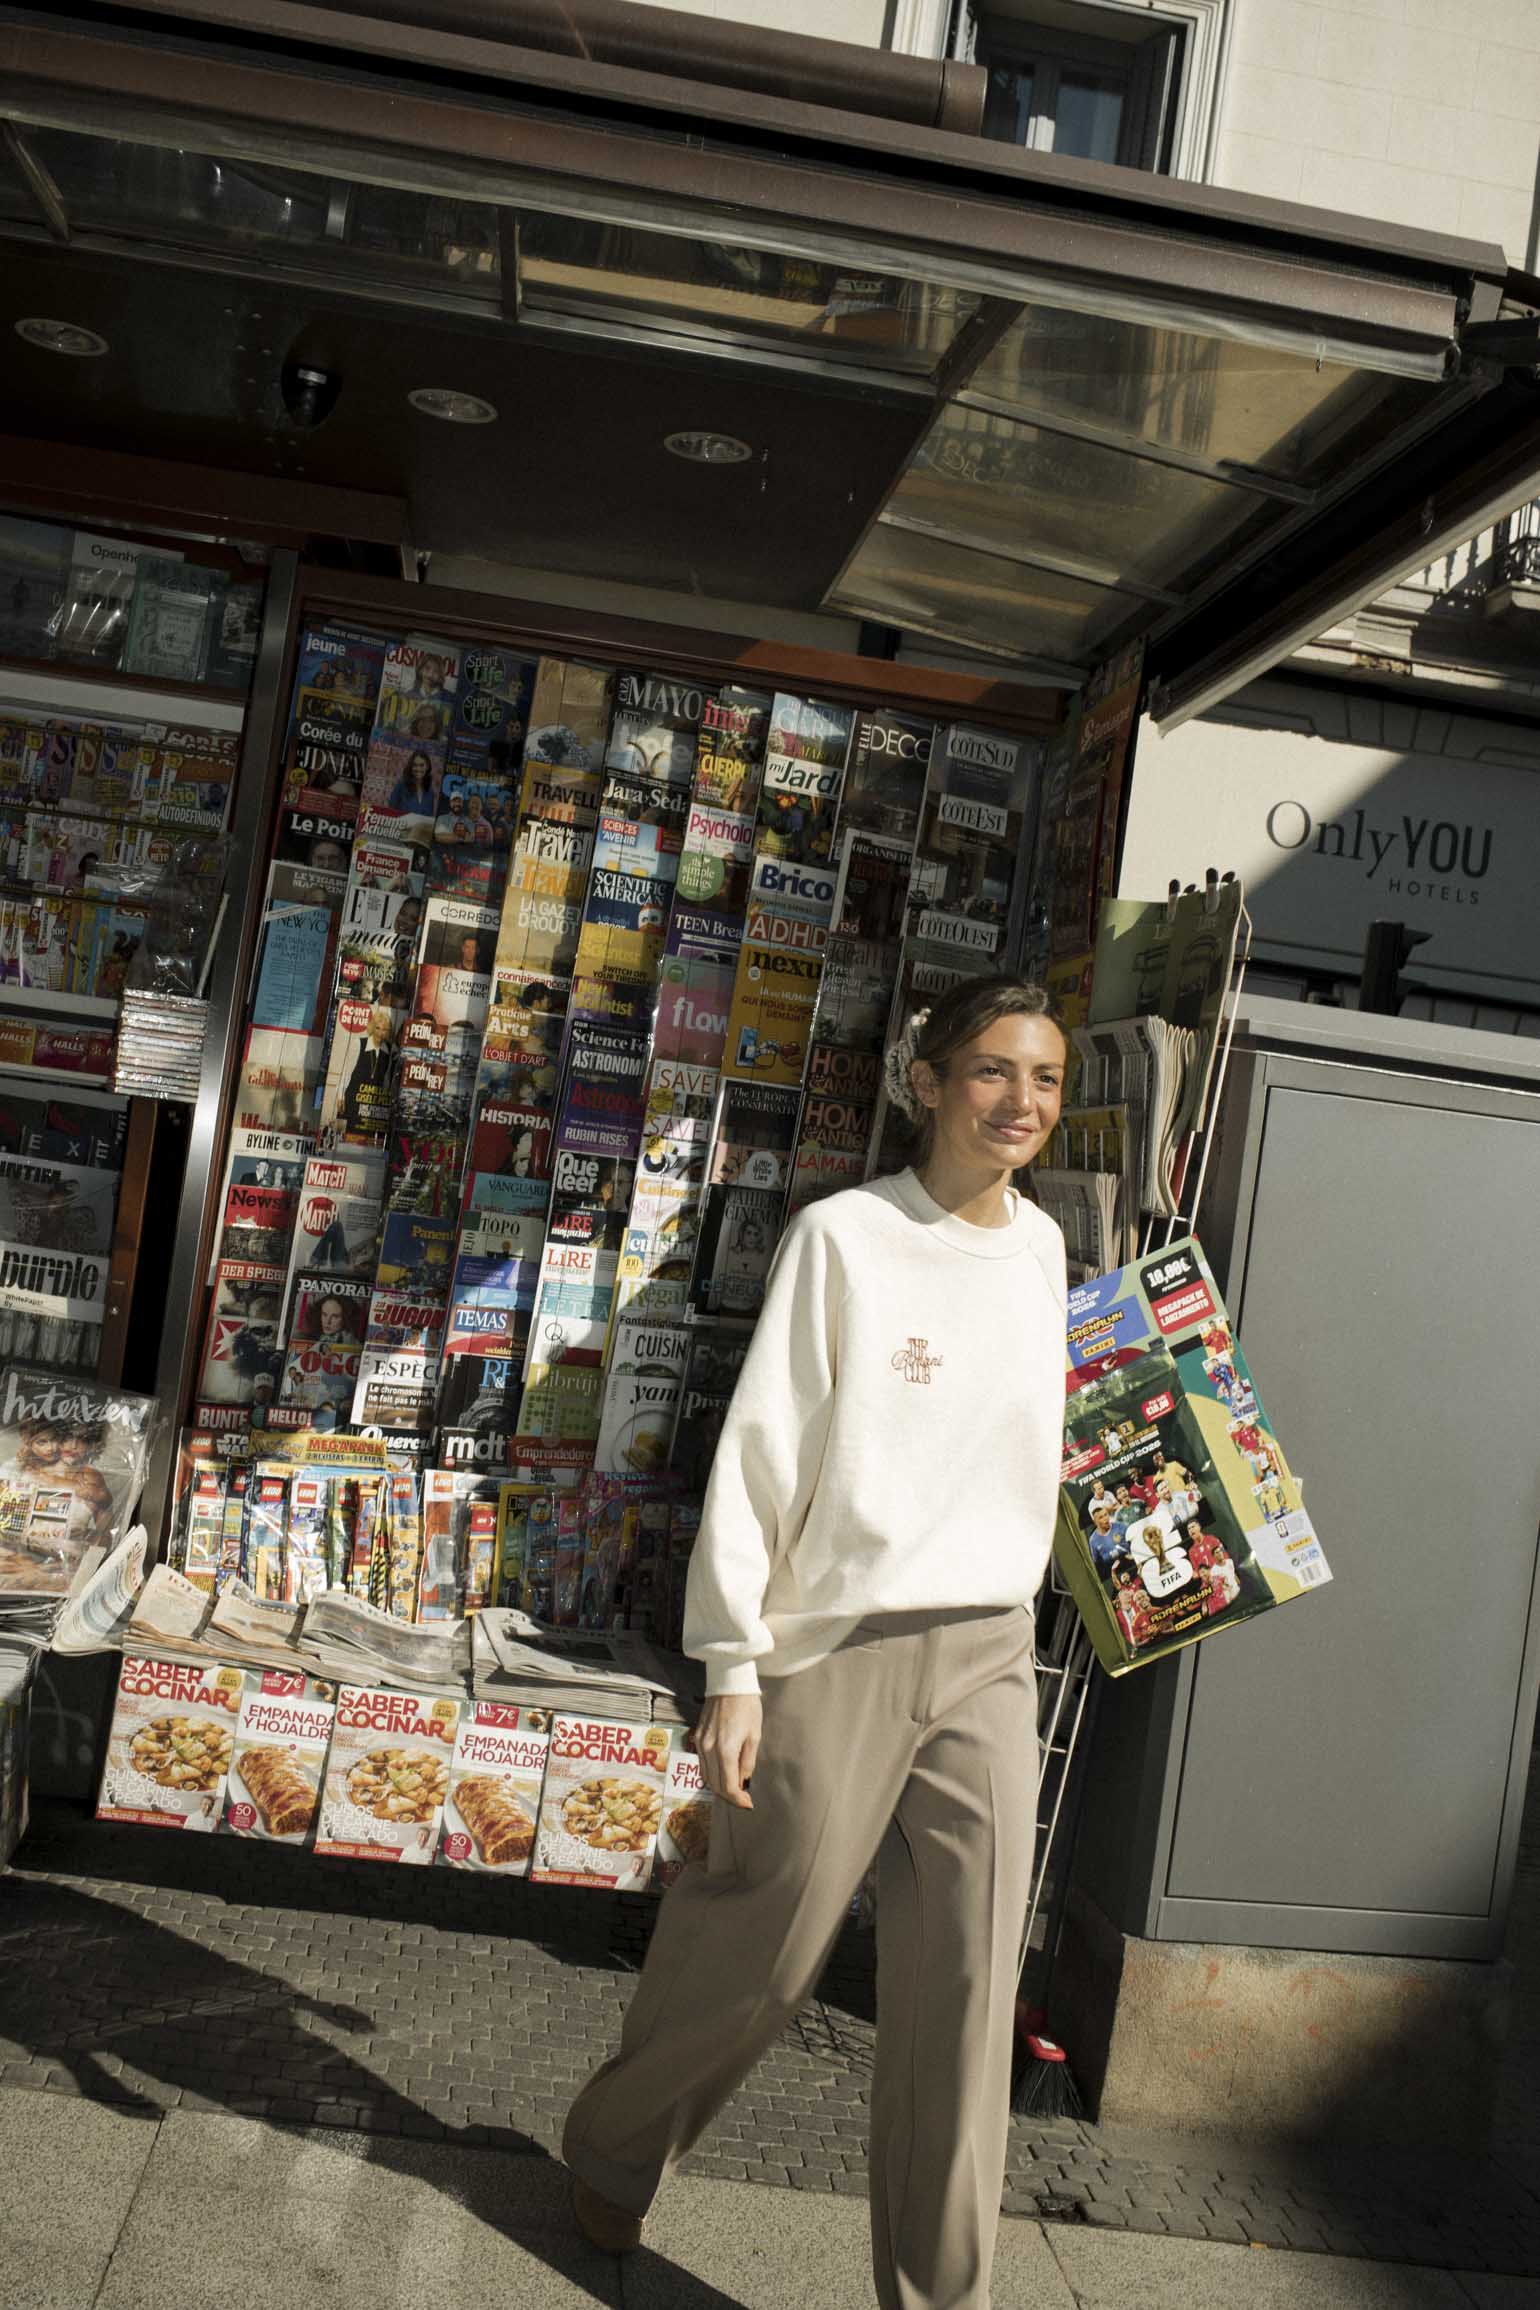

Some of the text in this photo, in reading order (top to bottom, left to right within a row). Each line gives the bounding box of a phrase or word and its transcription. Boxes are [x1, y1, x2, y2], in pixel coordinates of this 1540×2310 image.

[306, 633, 346, 657] jeune
[473, 667, 504, 686] Life
[470, 707, 501, 728] Life
[300, 721, 363, 748] Corée du
[603, 778, 643, 801] Jara
[291, 813, 313, 832] Le
[1266, 800, 1493, 878] Only YOU
[366, 853, 400, 867] France
[682, 865, 715, 879] simple
[595, 870, 669, 895] SCIENTIFIC
[682, 874, 712, 890] things
[760, 864, 833, 901] Brico
[1389, 878, 1480, 904] HOTELS
[520, 897, 538, 914] LA
[518, 912, 578, 936] DROUOT
[675, 914, 710, 934] TEEN
[342, 1006, 370, 1017] POINT
[342, 1015, 353, 1023] DE
[489, 1018, 529, 1037] Arts
[53, 1039, 85, 1051] HALLS
[572, 1028, 629, 1048] Science
[520, 1054, 547, 1067] D'ART
[733, 1087, 748, 1097] The
[479, 1108, 551, 1130] HISTORIA
[247, 1133, 281, 1150] BYLINE
[565, 1127, 629, 1146] RUBIN RISES
[559, 1152, 600, 1177] Que
[308, 1165, 346, 1187] MATCH
[302, 1203, 338, 1230] MATCH
[221, 1263, 245, 1278] DER
[455, 1310, 507, 1329] TEMAS
[368, 1394, 378, 1402] ne
[369, 1384, 379, 1393] Le
[199, 1408, 249, 1429] BUNTE
[268, 1408, 312, 1427] HELLO!
[1096, 1460, 1120, 1475] WORLD
[1120, 1453, 1135, 1464] CUP
[263, 1485, 280, 1496] LEGO
[299, 1490, 314, 1498] LEGO
[1160, 1571, 1182, 1589] FIFA
[123, 1657, 204, 1684] SABER
[120, 1676, 230, 1708] COCINAR
[340, 1690, 419, 1717] SABER
[336, 1709, 446, 1738] COCINAR
[555, 1720, 632, 1746] SABER
[551, 1740, 658, 1767] COCINAR
[124, 1783, 174, 1798] CARNE
[236, 1804, 251, 1816] 50
[451, 1837, 466, 1847] 50
